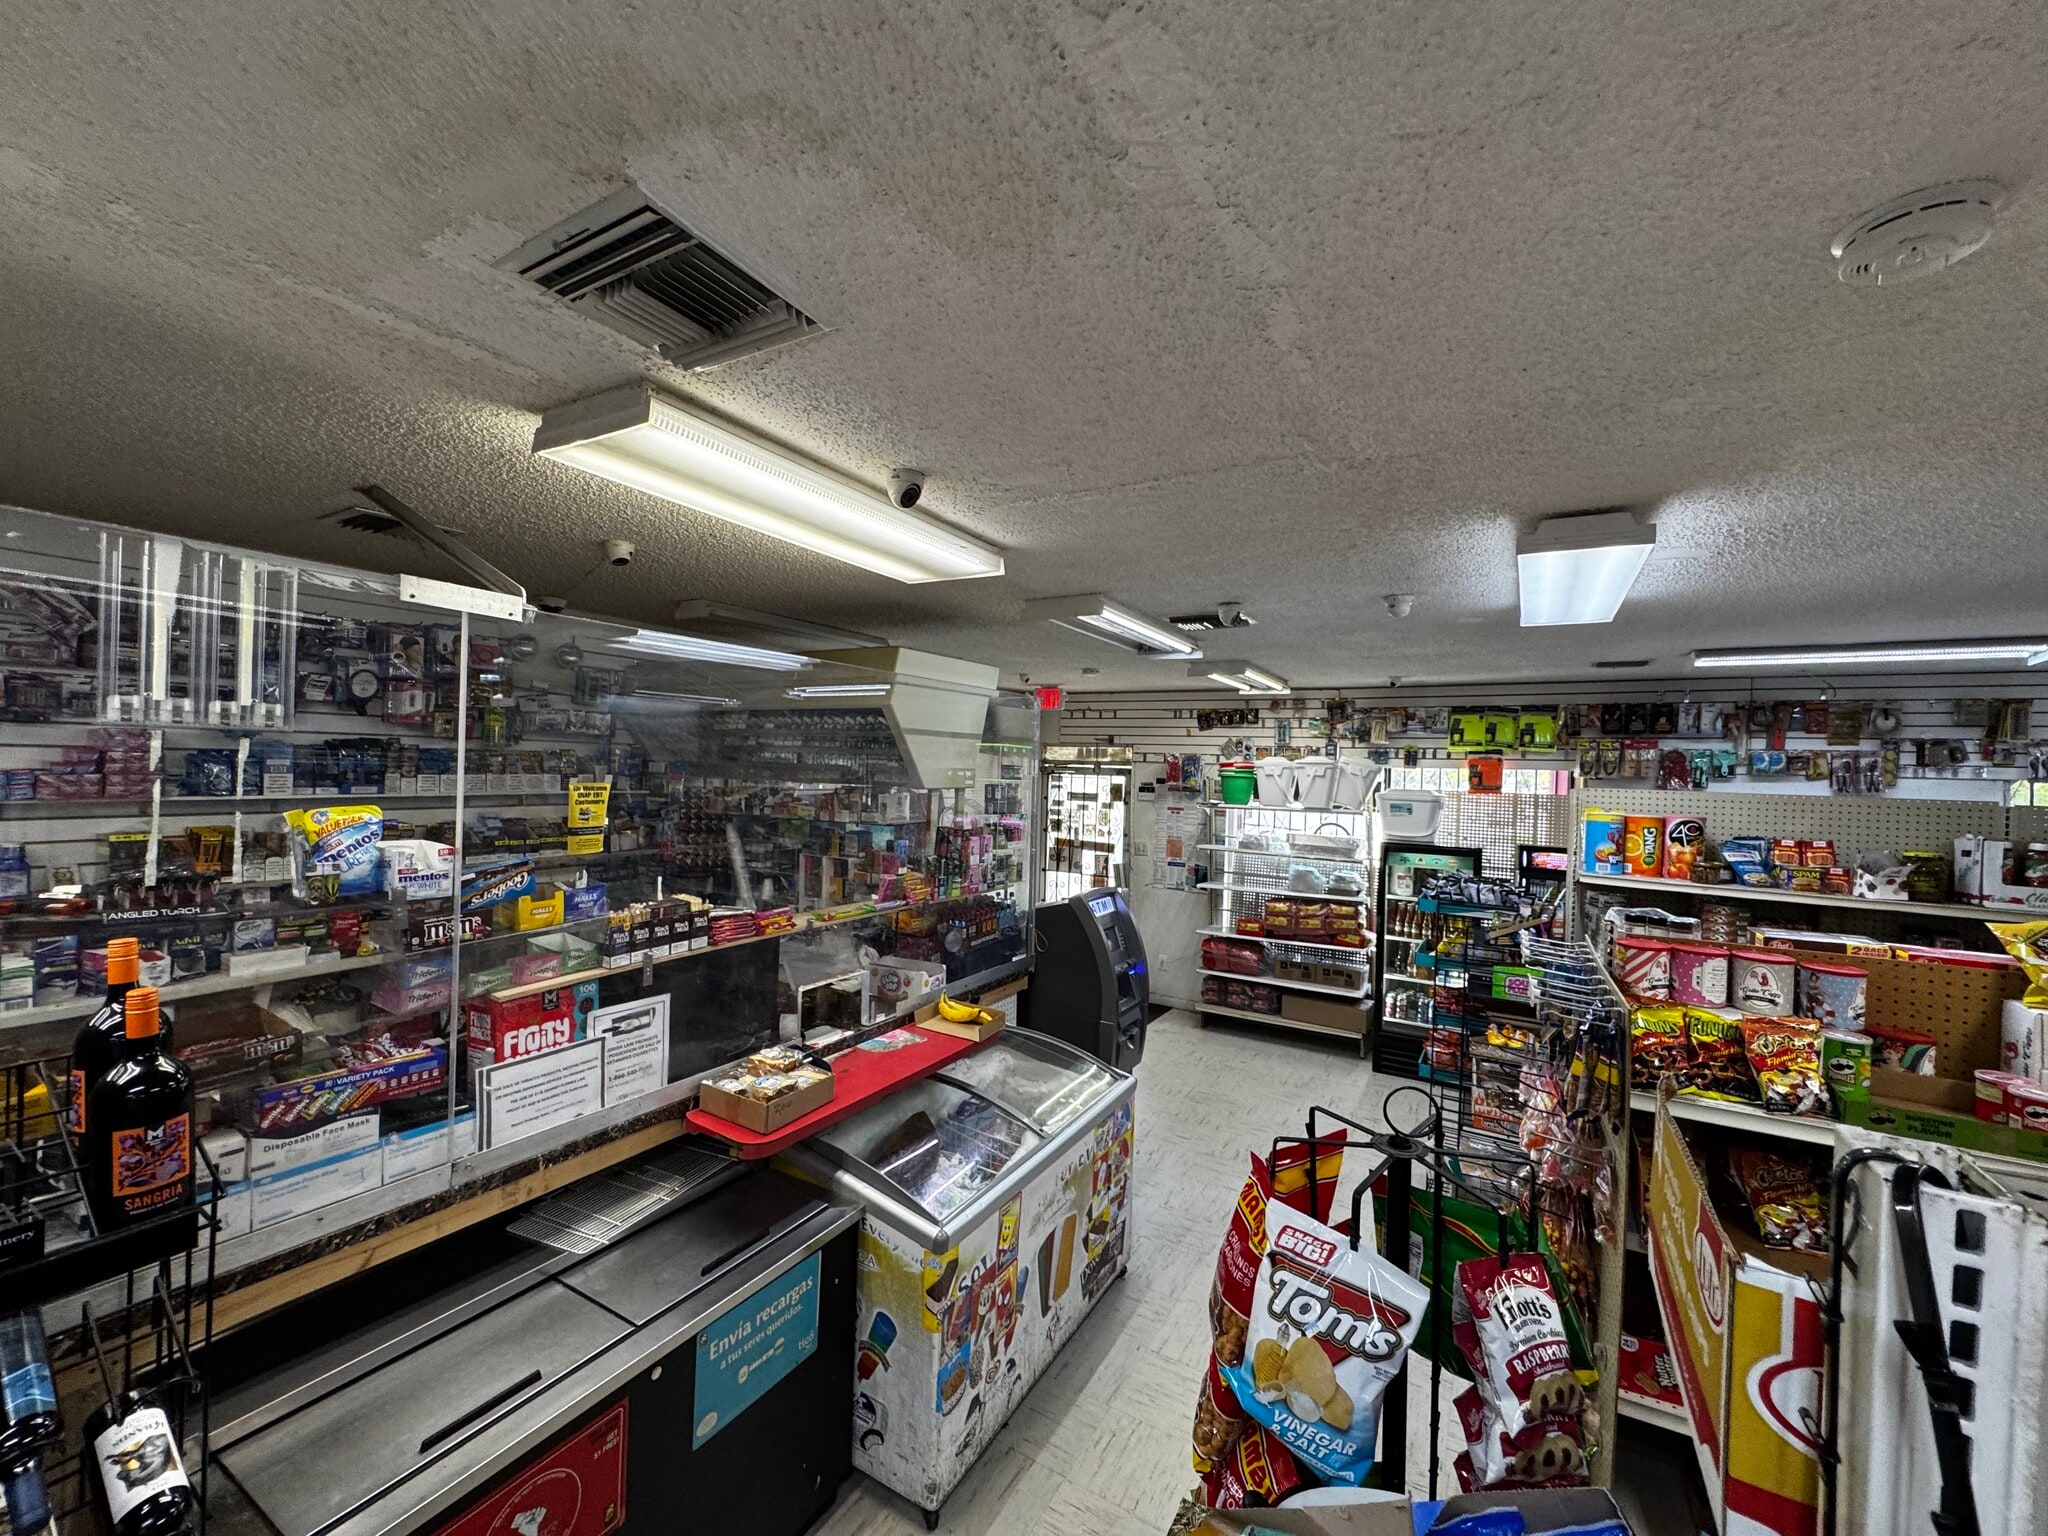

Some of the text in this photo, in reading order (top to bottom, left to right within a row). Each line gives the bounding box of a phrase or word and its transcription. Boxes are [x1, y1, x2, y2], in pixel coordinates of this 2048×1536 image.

[316, 827, 382, 864] mentos
[1643, 827, 1657, 854] TANG
[398, 871, 449, 883] mentos
[470, 870, 529, 908] Goobers
[1792, 869, 1821, 879] SPAM
[108, 908, 160, 920] ANGLED
[579, 983, 596, 994] 100
[336, 1070, 372, 1085] VARIETY
[372, 1066, 396, 1077] PACK
[263, 1116, 371, 1154] Disposable Face Mask
[124, 1182, 184, 1211] SANGRIA
[1277, 1234, 1329, 1265] BIG!
[1283, 1228, 1335, 1251] SNACK
[709, 1318, 752, 1361] Envía
[755, 1275, 814, 1328] recargas
[727, 1347, 743, 1364] tus
[743, 1332, 766, 1354] seres
[1270, 1424, 1332, 1460] & SALT
[1273, 1409, 1359, 1457] VINEGAR
